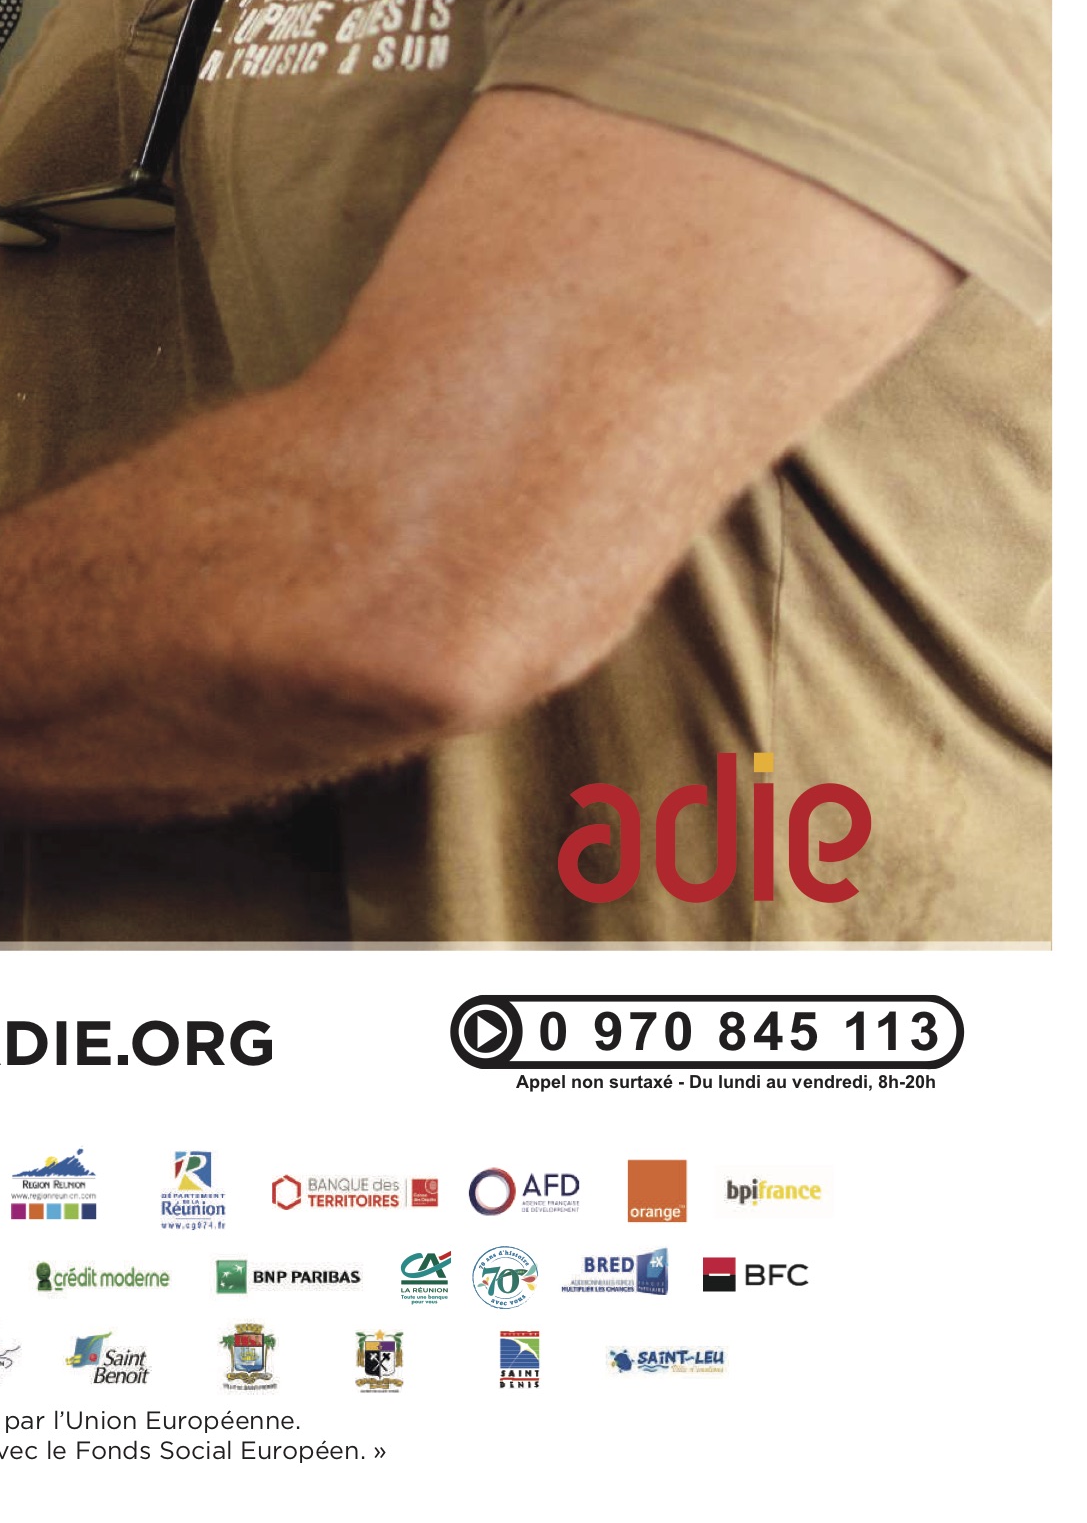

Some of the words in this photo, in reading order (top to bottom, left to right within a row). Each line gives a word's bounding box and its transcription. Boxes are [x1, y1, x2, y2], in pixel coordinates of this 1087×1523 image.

[372, 35, 450, 71] SUN
[557, 752, 872, 904] adie
[539, 1011, 567, 1052] 0
[594, 1011, 692, 1052] 970
[718, 1011, 818, 1052] 845
[845, 1011, 939, 1052] 113
[515, 1074, 566, 1093] Appel
[571, 1077, 604, 1089] non
[608, 1073, 674, 1089] surtaxé
[689, 1074, 713, 1089] Du
[718, 1074, 761, 1089] lundi
[765, 1077, 787, 1089] au
[791, 1074, 873, 1092] vendredi,
[878, 1074, 936, 1089] 8h-20h
[308, 1178, 369, 1192] BANQUE
[372, 1178, 400, 1192] des
[522, 1173, 580, 1197] AFD
[727, 1179, 822, 1206] bpifrance
[161, 1200, 226, 1216] Réunion
[307, 1194, 400, 1207] TERRITOIRES
[630, 1206, 681, 1221] orange
[584, 1256, 635, 1273] BRED
[746, 1264, 809, 1286] BFC
[54, 1267, 98, 1291] crédit
[99, 1267, 170, 1287] moderne
[253, 1270, 288, 1284] BNP
[291, 1270, 361, 1284] PARIBAS
[482, 1266, 520, 1296] 70
[103, 1348, 147, 1366] Saint
[93, 1366, 150, 1384] Benoît
[500, 1369, 540, 1378] SAINT
[5, 1415, 46, 1434] par
[54, 1410, 137, 1430] l’Union
[146, 1409, 300, 1434] Européenne.
[47, 1440, 67, 1460] le
[76, 1440, 151, 1460] Fonds
[159, 1440, 232, 1460] Social
[241, 1439, 365, 1464] Européen.
